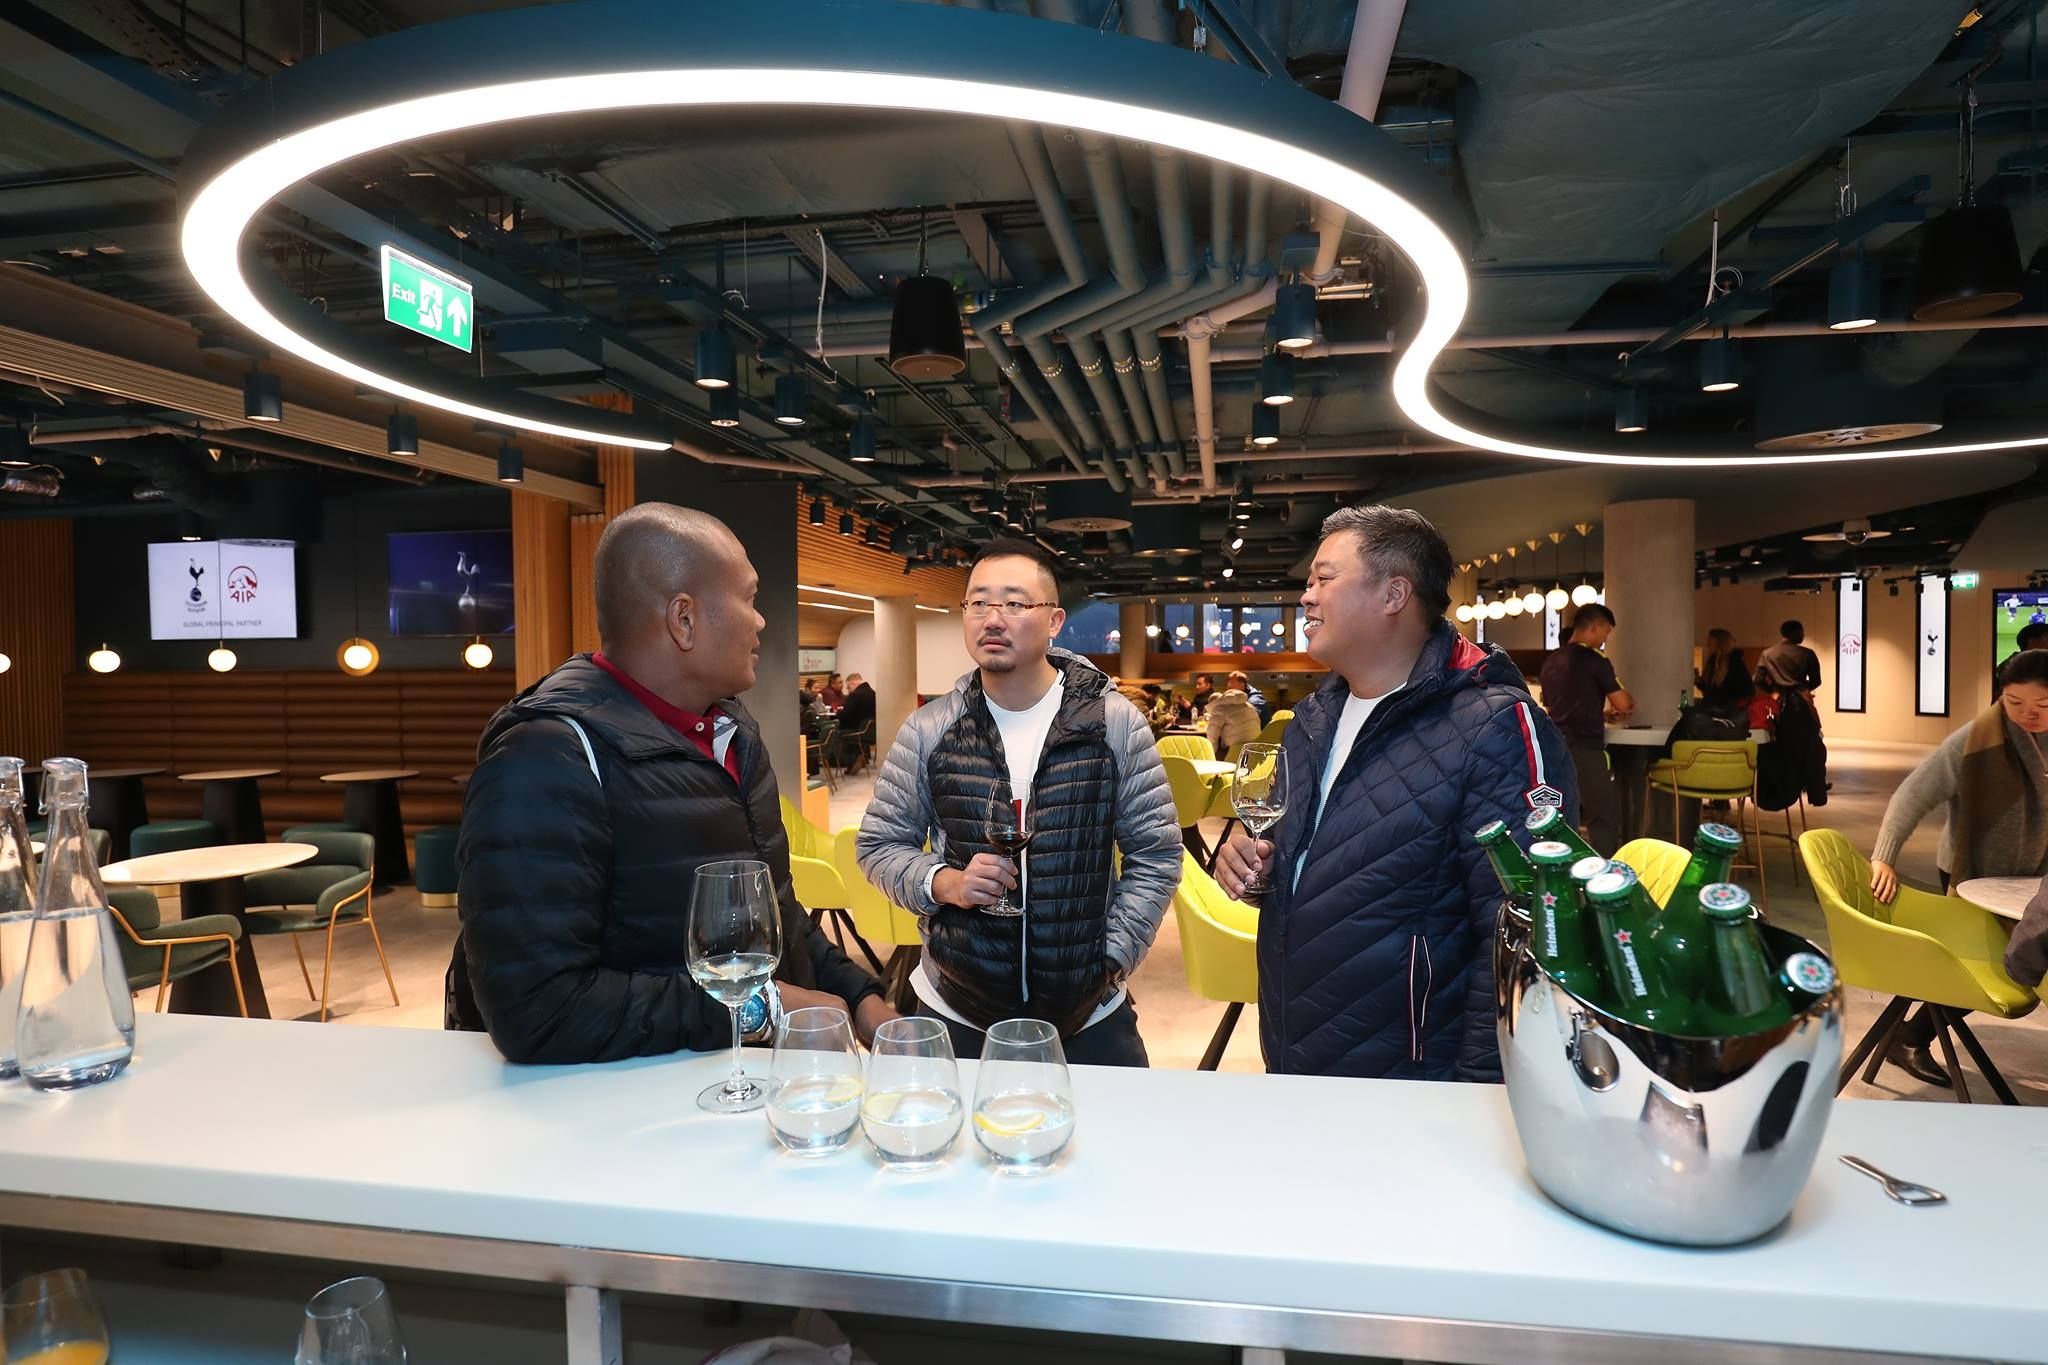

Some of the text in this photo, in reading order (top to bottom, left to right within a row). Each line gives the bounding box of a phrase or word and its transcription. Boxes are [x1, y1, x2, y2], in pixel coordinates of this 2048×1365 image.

[392, 281, 416, 305] Exit
[230, 590, 256, 603] AIA
[1544, 908, 1558, 957] Heineken
[1622, 946, 1648, 997] Heineken
